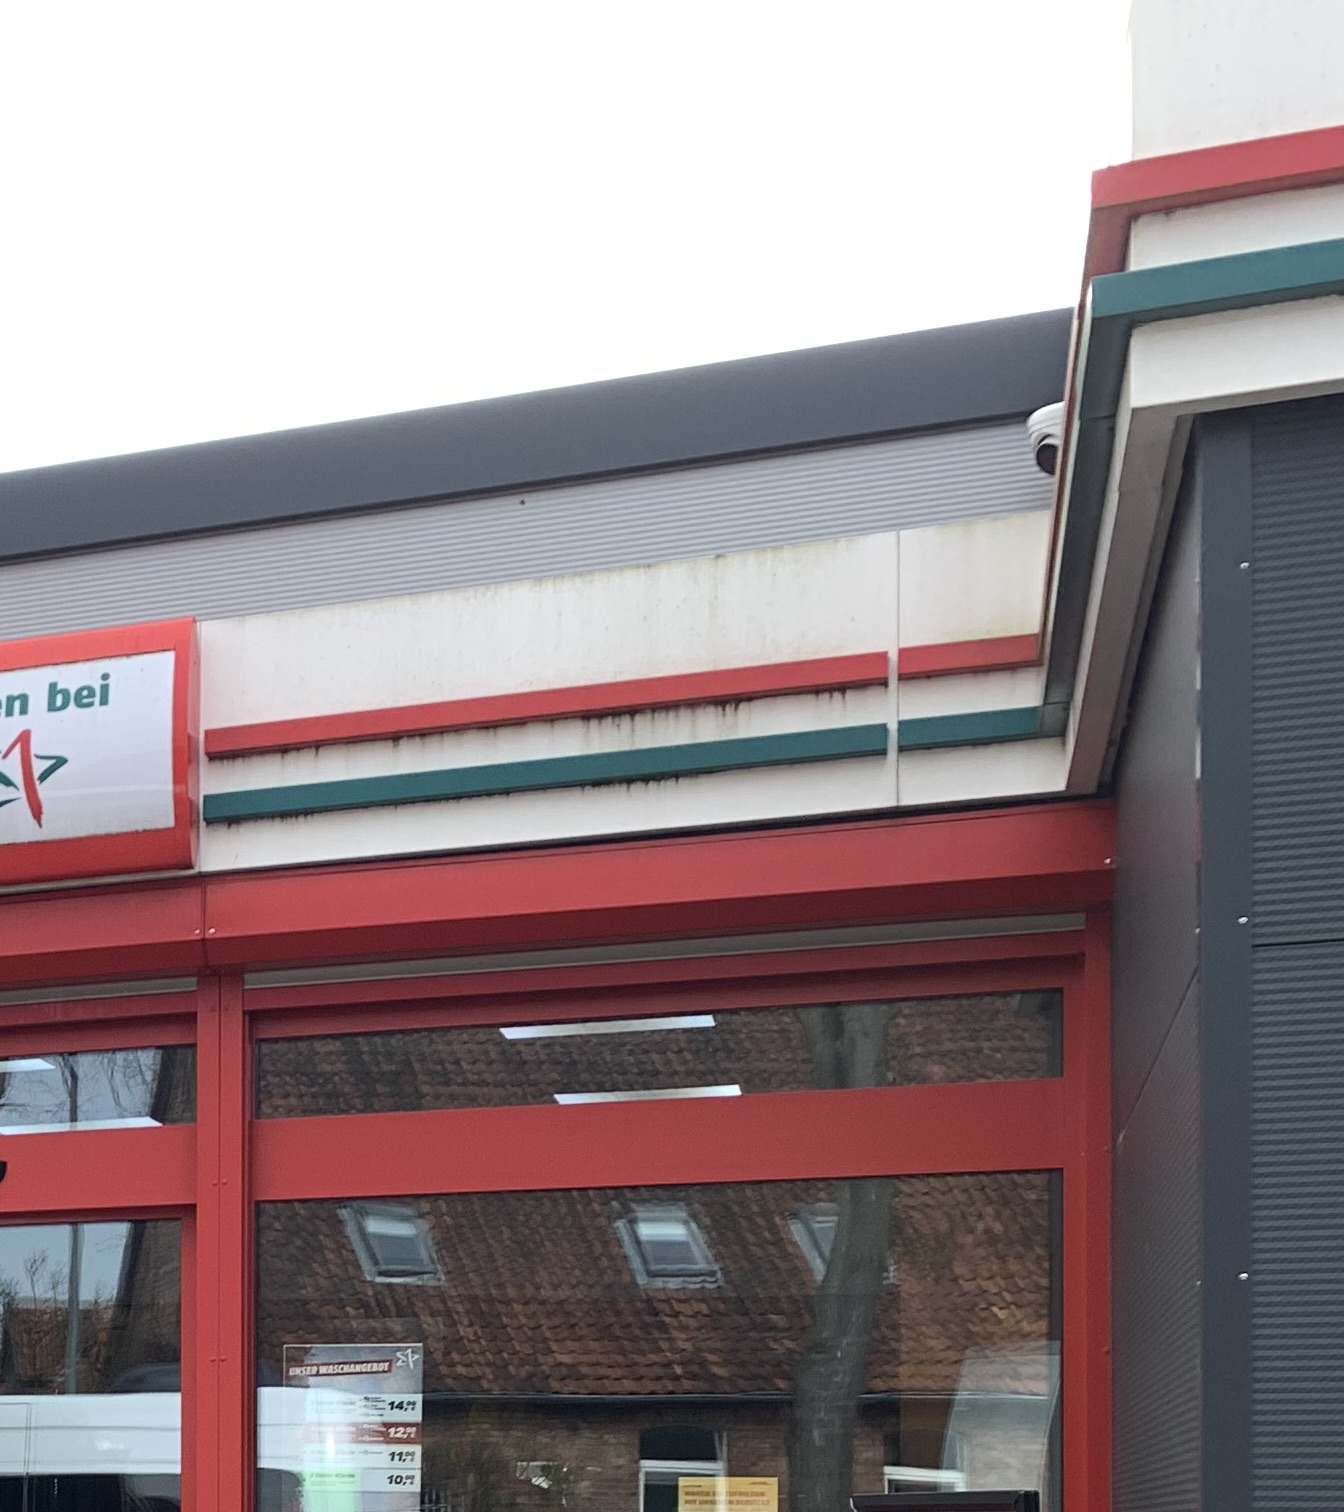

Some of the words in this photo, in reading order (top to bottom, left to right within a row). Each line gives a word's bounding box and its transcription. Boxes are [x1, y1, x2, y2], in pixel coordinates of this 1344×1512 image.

[46, 672, 112, 714] bei
[288, 1365, 318, 1377] UNSER
[318, 1361, 390, 1375] WASCHANGEBOT
